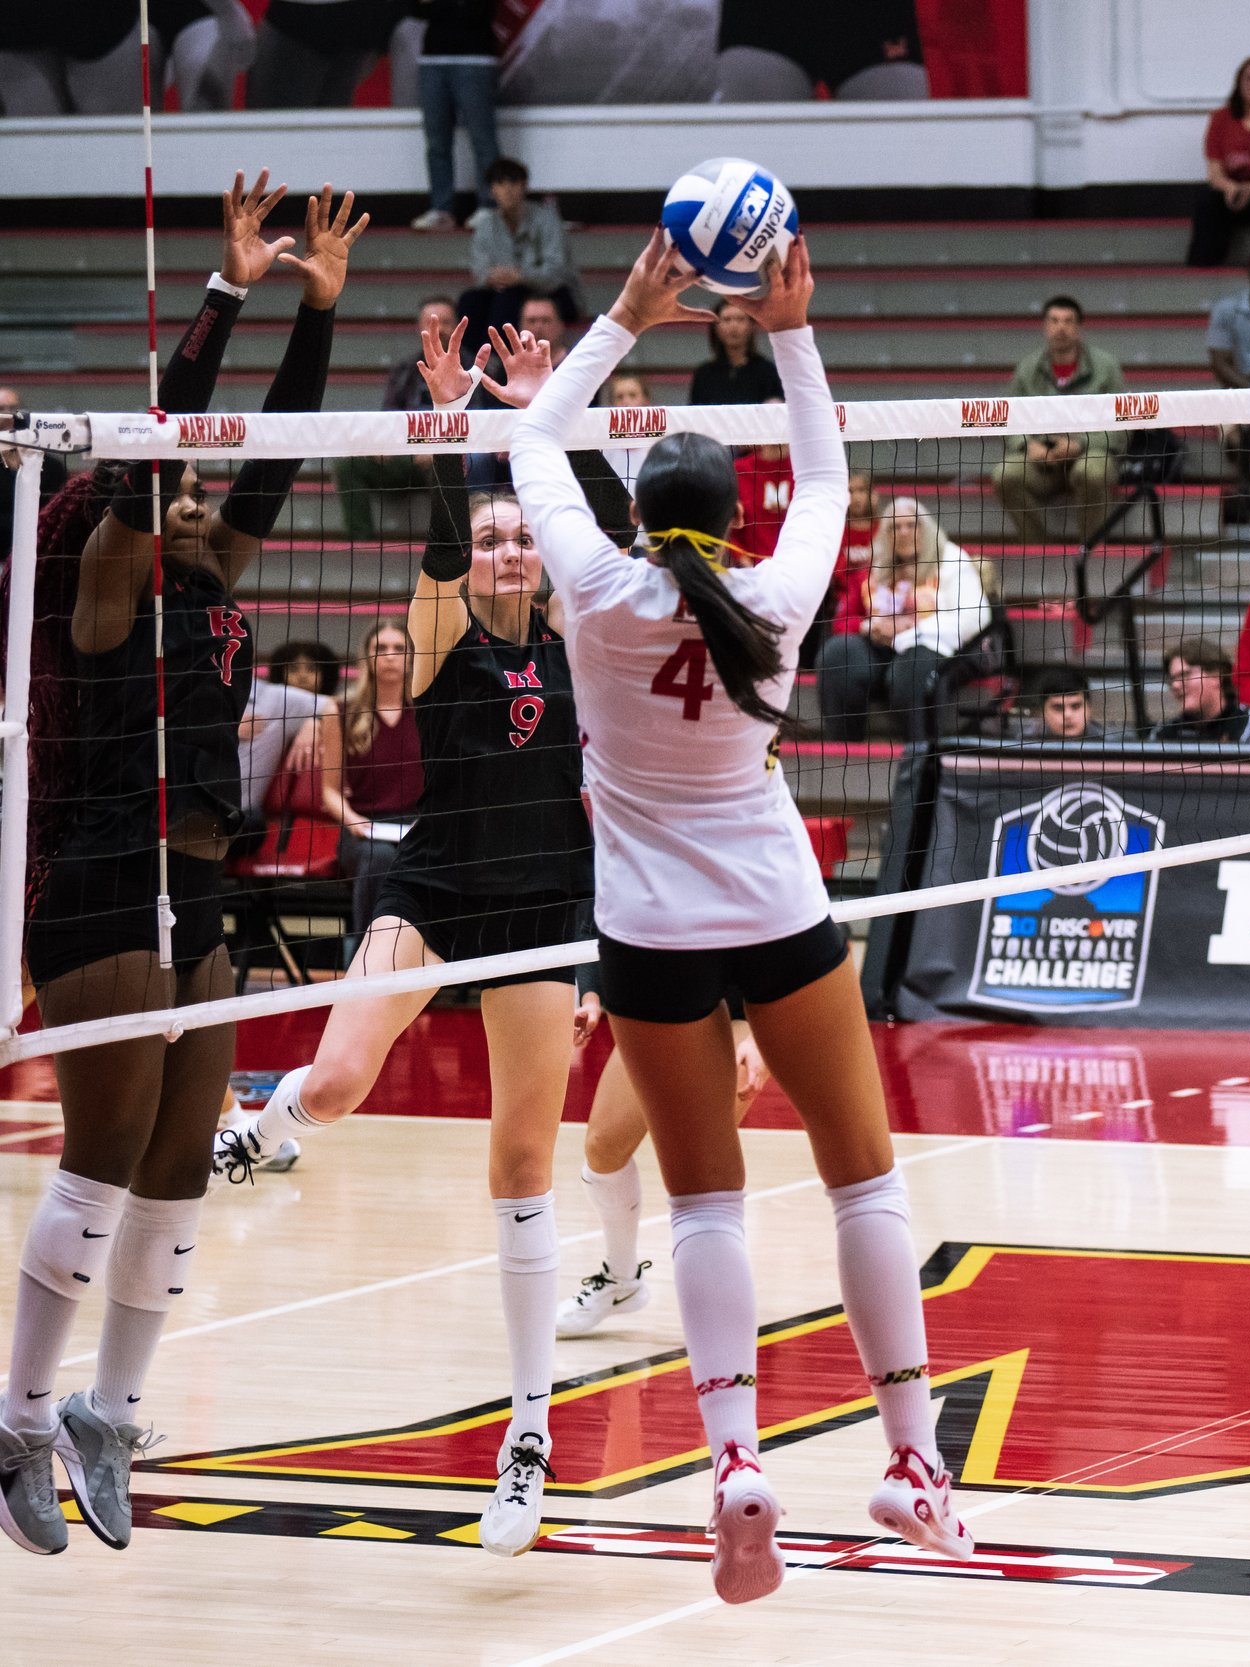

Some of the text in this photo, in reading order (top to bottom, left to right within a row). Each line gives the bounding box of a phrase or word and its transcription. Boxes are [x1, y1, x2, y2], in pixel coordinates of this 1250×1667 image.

[727, 180, 771, 242] NCAA
[744, 194, 786, 260] molten
[608, 408, 667, 434] MARYLAND
[961, 400, 1009, 425] MARYLAND
[1115, 394, 1160, 420] MARYLAND
[43, 421, 67, 430] Senoh
[177, 415, 246, 443] MARYLAND
[406, 412, 469, 438] MARYLAND
[764, 481, 790, 510] M
[207, 605, 248, 637] R
[651, 638, 714, 721] 4
[508, 694, 545, 748] 9
[1050, 918, 1138, 938] DISCOVER
[991, 938, 1134, 961] VOLLEYBALL
[985, 959, 1134, 989] CHALLENGE
